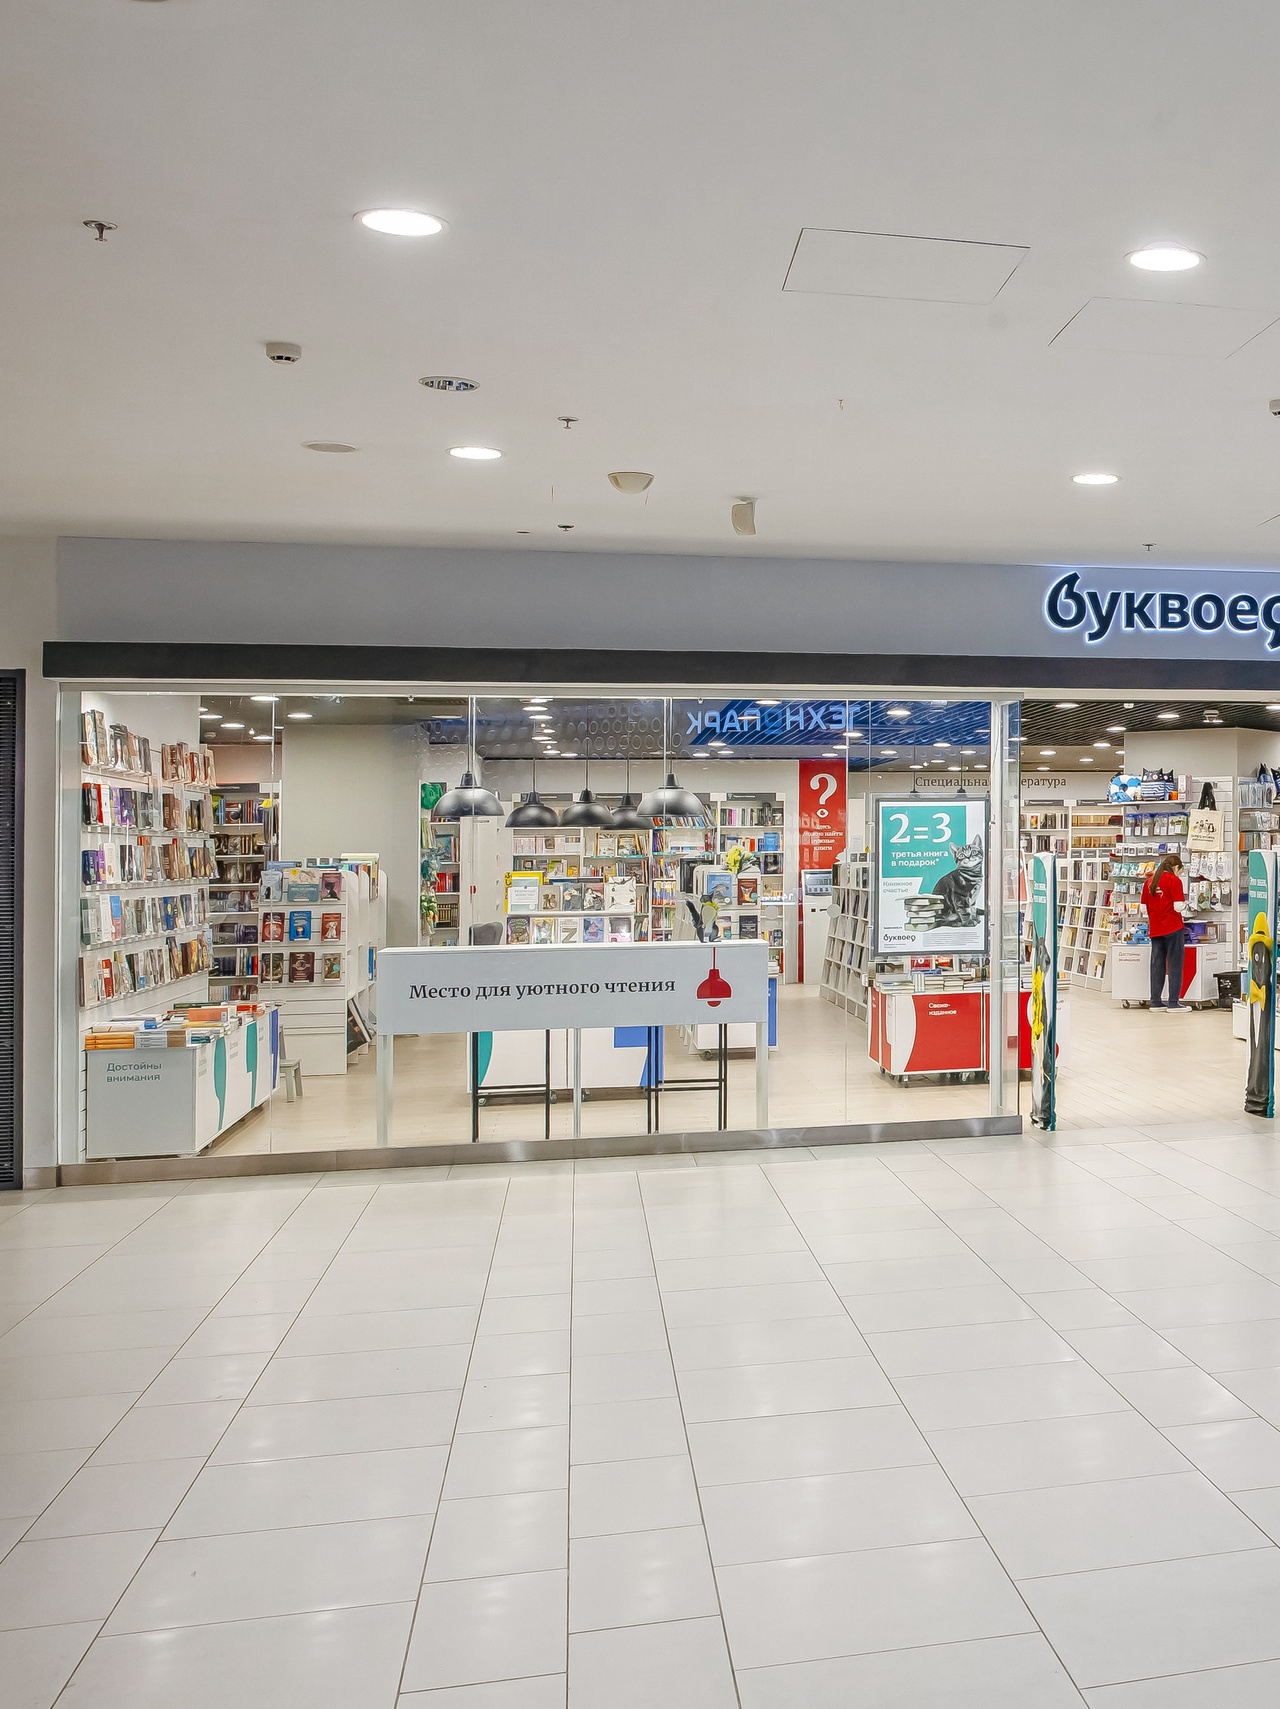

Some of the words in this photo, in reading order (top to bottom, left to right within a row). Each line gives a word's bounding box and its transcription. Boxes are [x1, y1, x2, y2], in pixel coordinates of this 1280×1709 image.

[915, 776, 991, 789] Специальна
[889, 811, 952, 844] 2=3
[891, 851, 922, 859] третья
[923, 850, 949, 858] книга
[883, 933, 917, 942] буквоед
[408, 983, 472, 1000] Место
[475, 984, 512, 1001] для
[515, 980, 601, 1000] уютного
[604, 979, 676, 994] чтения
[106, 1061, 162, 1073] Достойны
[106, 1073, 161, 1083] внимания
